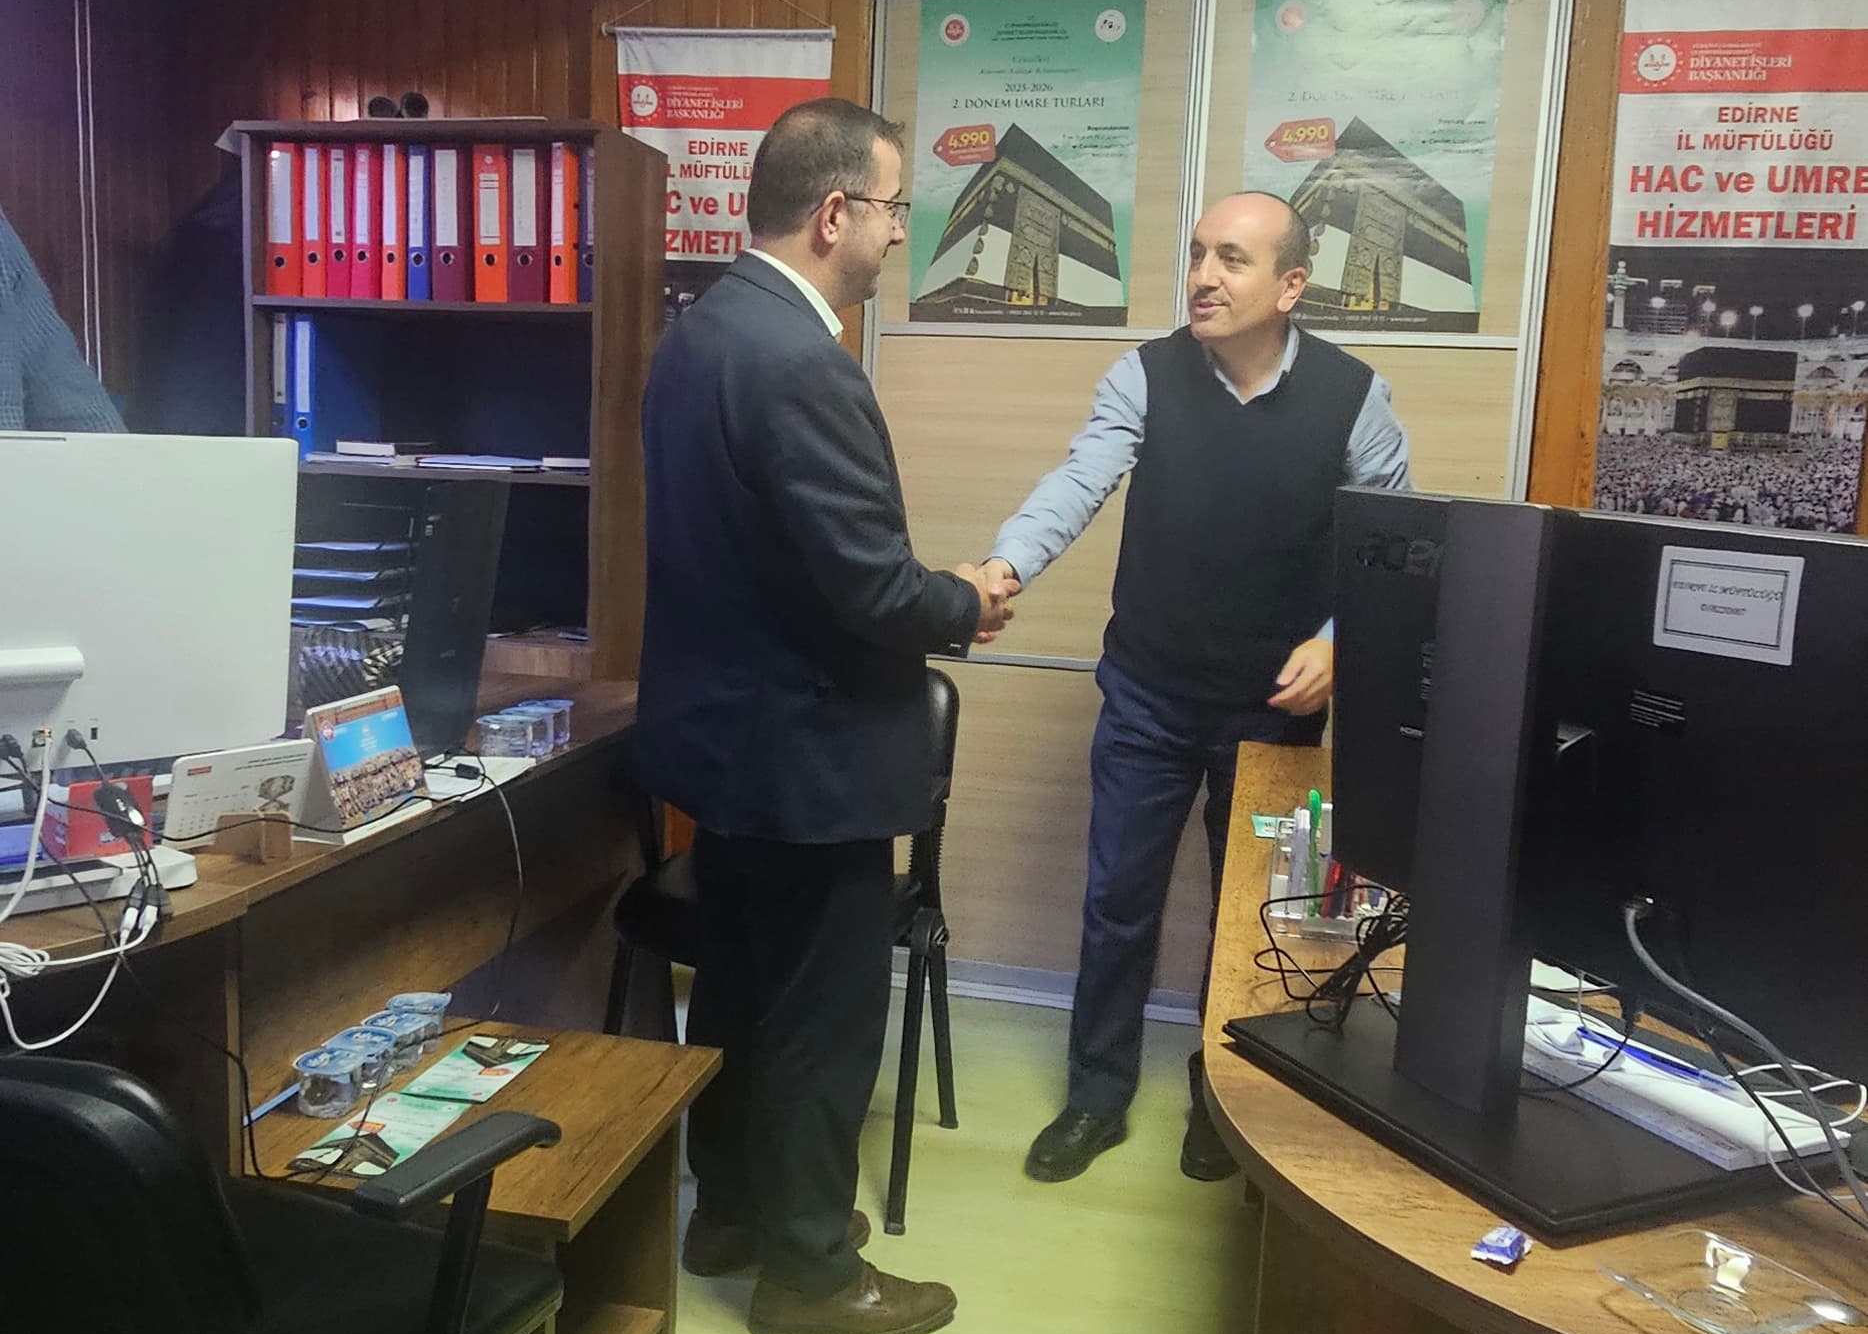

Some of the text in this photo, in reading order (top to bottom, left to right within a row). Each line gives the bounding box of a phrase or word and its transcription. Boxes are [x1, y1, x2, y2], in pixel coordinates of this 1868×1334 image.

[1690, 55, 1749, 68] DİYANET
[1688, 68, 1767, 82] BAŞKANLIĞI
[1004, 82, 1054, 93] 2025-2026
[965, 96, 1012, 108] DÖNEM
[1015, 97, 1049, 108] UMRE
[1053, 96, 1105, 108] TURLARI
[1717, 102, 1799, 123] EDİRNE
[948, 130, 990, 148] 4.990
[1281, 125, 1329, 144] 4.990
[1676, 128, 1833, 151] İL MÜFTÜLÜĞÜ
[688, 137, 749, 156] EDİRNE
[680, 160, 752, 180] MÜFTÜLÜ
[1629, 164, 1868, 194] HAC ve UMRE
[689, 196, 719, 216] ve
[1636, 203, 1857, 240] HİZMETLERİ
